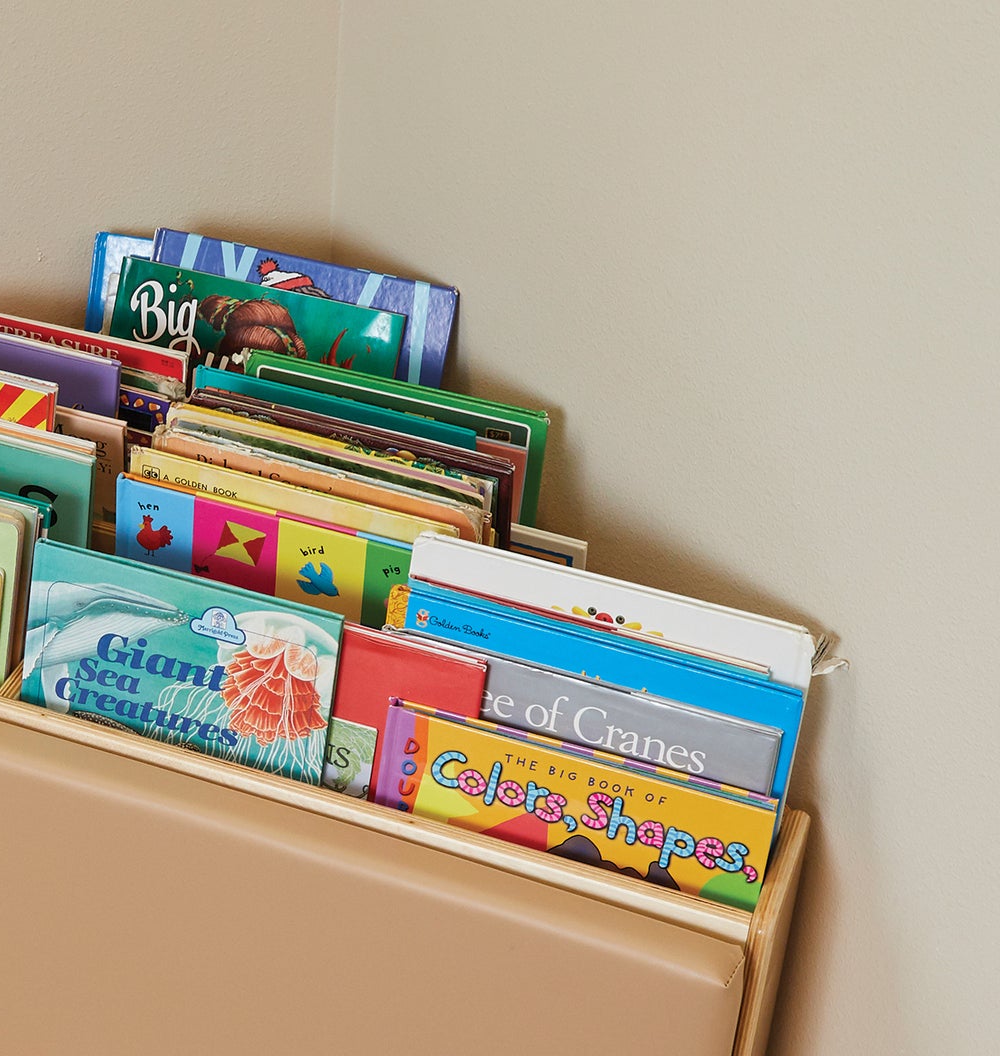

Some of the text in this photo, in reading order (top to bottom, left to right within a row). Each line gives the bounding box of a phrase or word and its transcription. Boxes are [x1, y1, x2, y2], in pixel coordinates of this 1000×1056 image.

[130, 279, 201, 356] Big
[137, 501, 160, 511] hen
[174, 476, 208, 491] GOLDEN
[212, 486, 238, 499] BOOK
[300, 545, 325, 557] bird
[382, 564, 401, 578] pig
[429, 615, 461, 632] Golden
[75, 657, 140, 694] Sea
[96, 632, 228, 692] Giant
[55, 677, 239, 748] Creatures
[525, 695, 569, 733] of
[573, 705, 706, 774] Cranes
[505, 753, 668, 805] THE BIG BOOK OF
[430, 750, 759, 884] Colors, Shapes,
